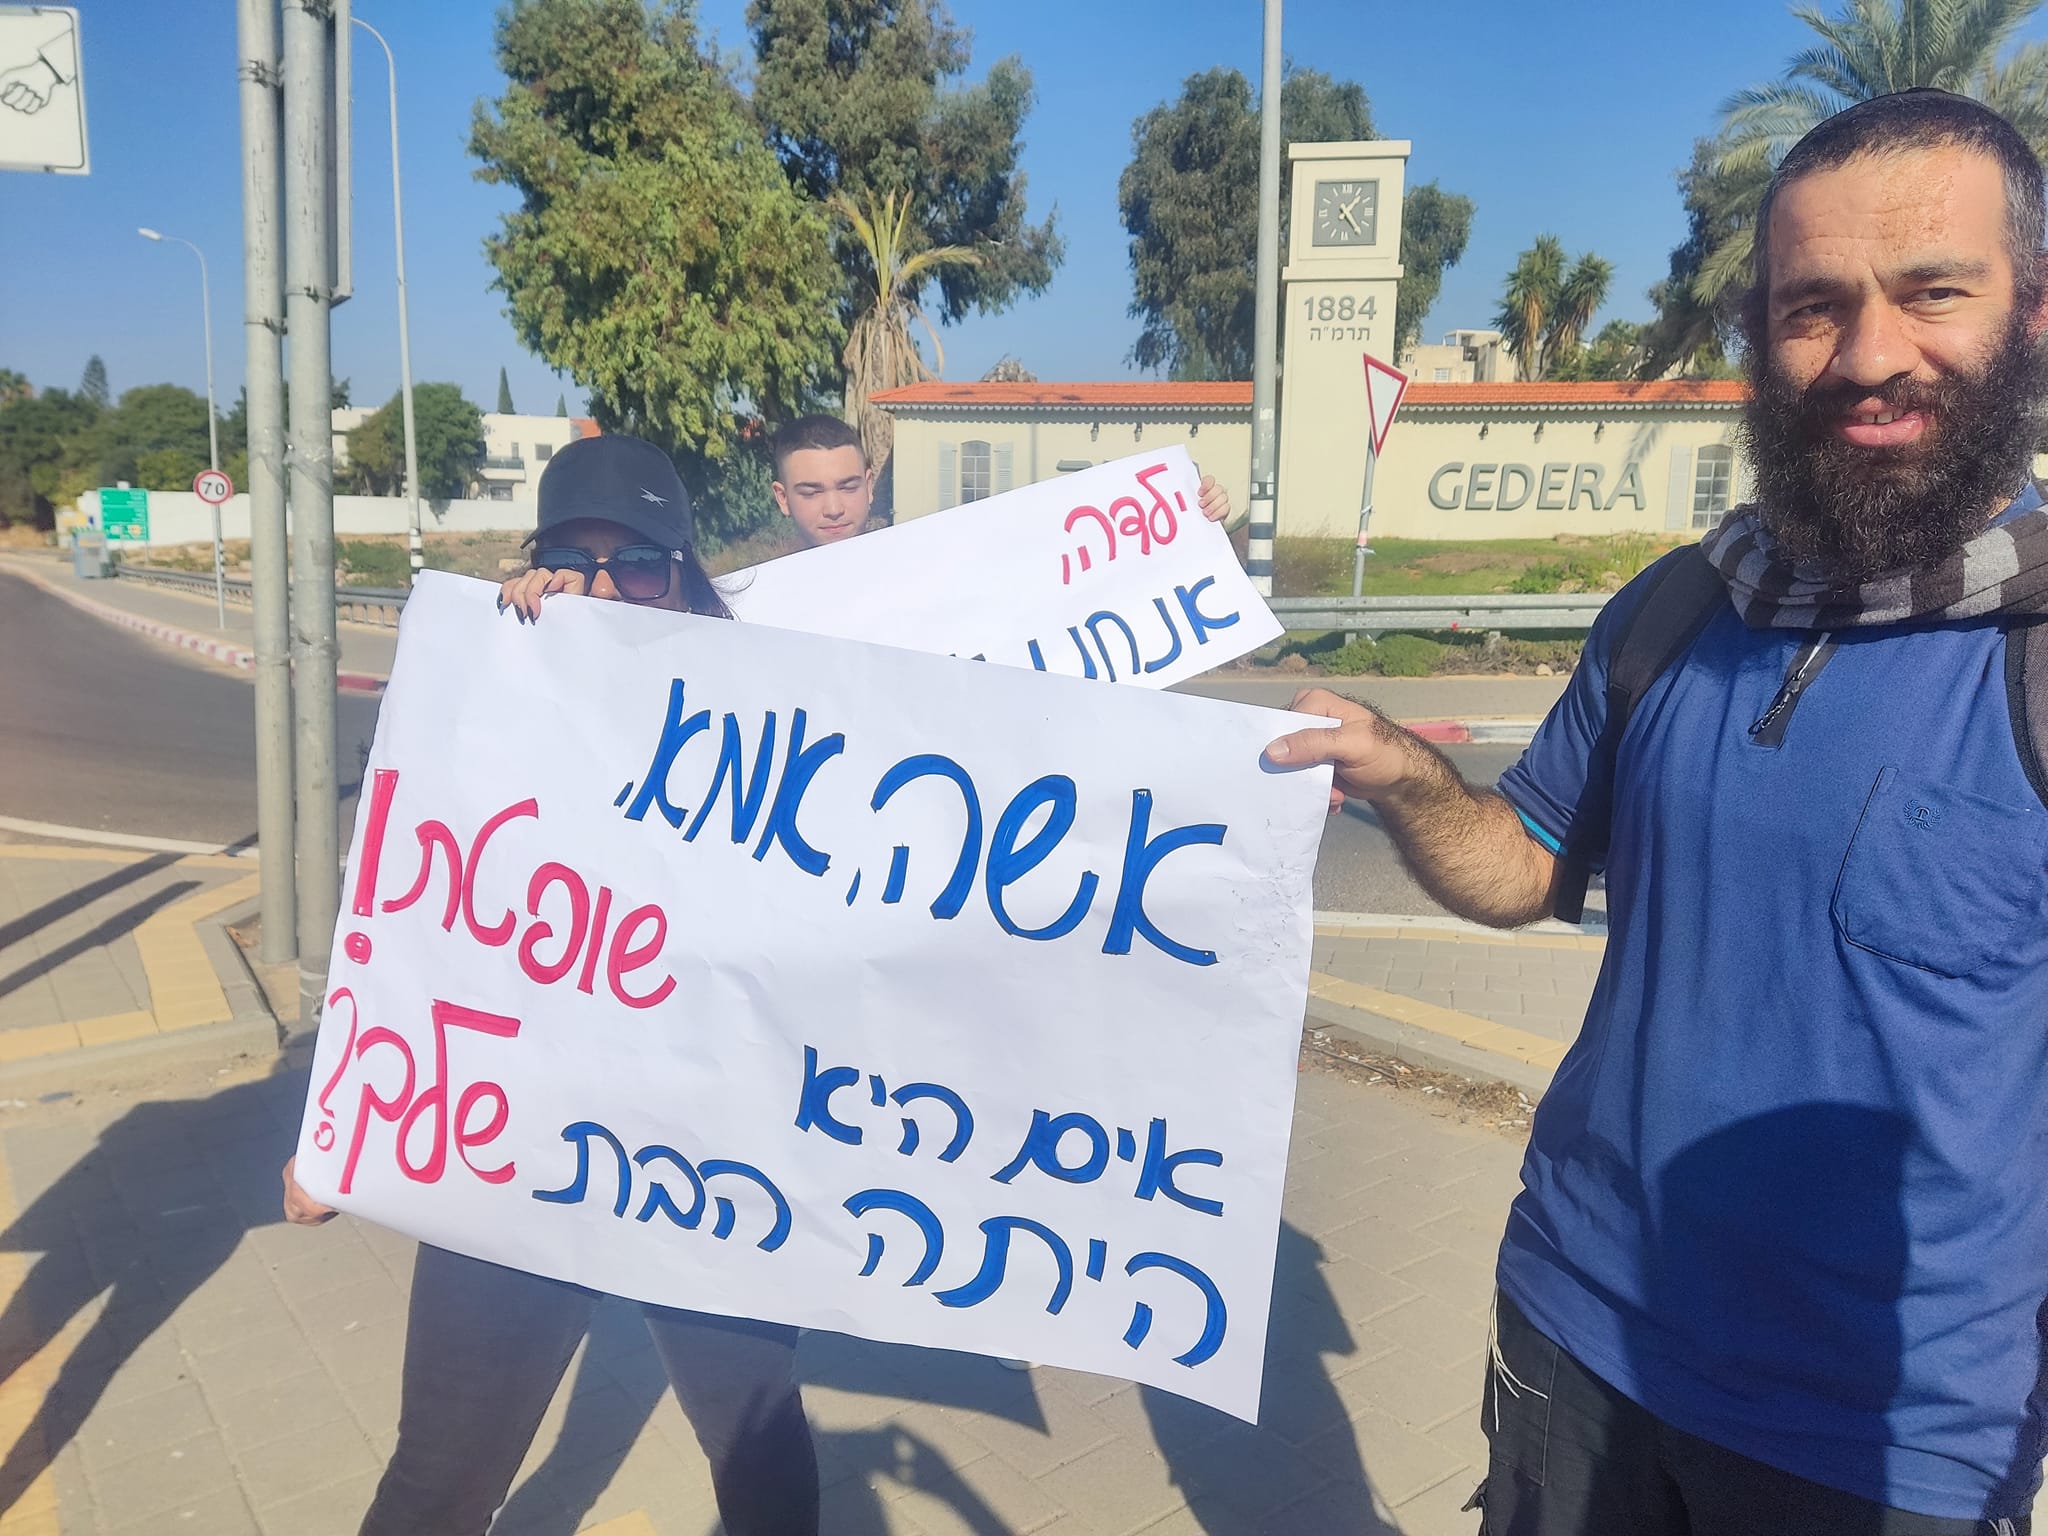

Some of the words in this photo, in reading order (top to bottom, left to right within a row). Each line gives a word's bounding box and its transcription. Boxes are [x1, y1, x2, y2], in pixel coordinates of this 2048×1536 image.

[1304, 295, 1377, 321] 1884
[202, 482, 225, 496] 70
[1428, 462, 1647, 511] GEDERA
[344, 768, 678, 1009] שופטת!
[313, 987, 523, 1195] שלך?
[794, 1044, 976, 1163] היא
[531, 1120, 793, 1253] הבת
[842, 1187, 1228, 1369] היתה
